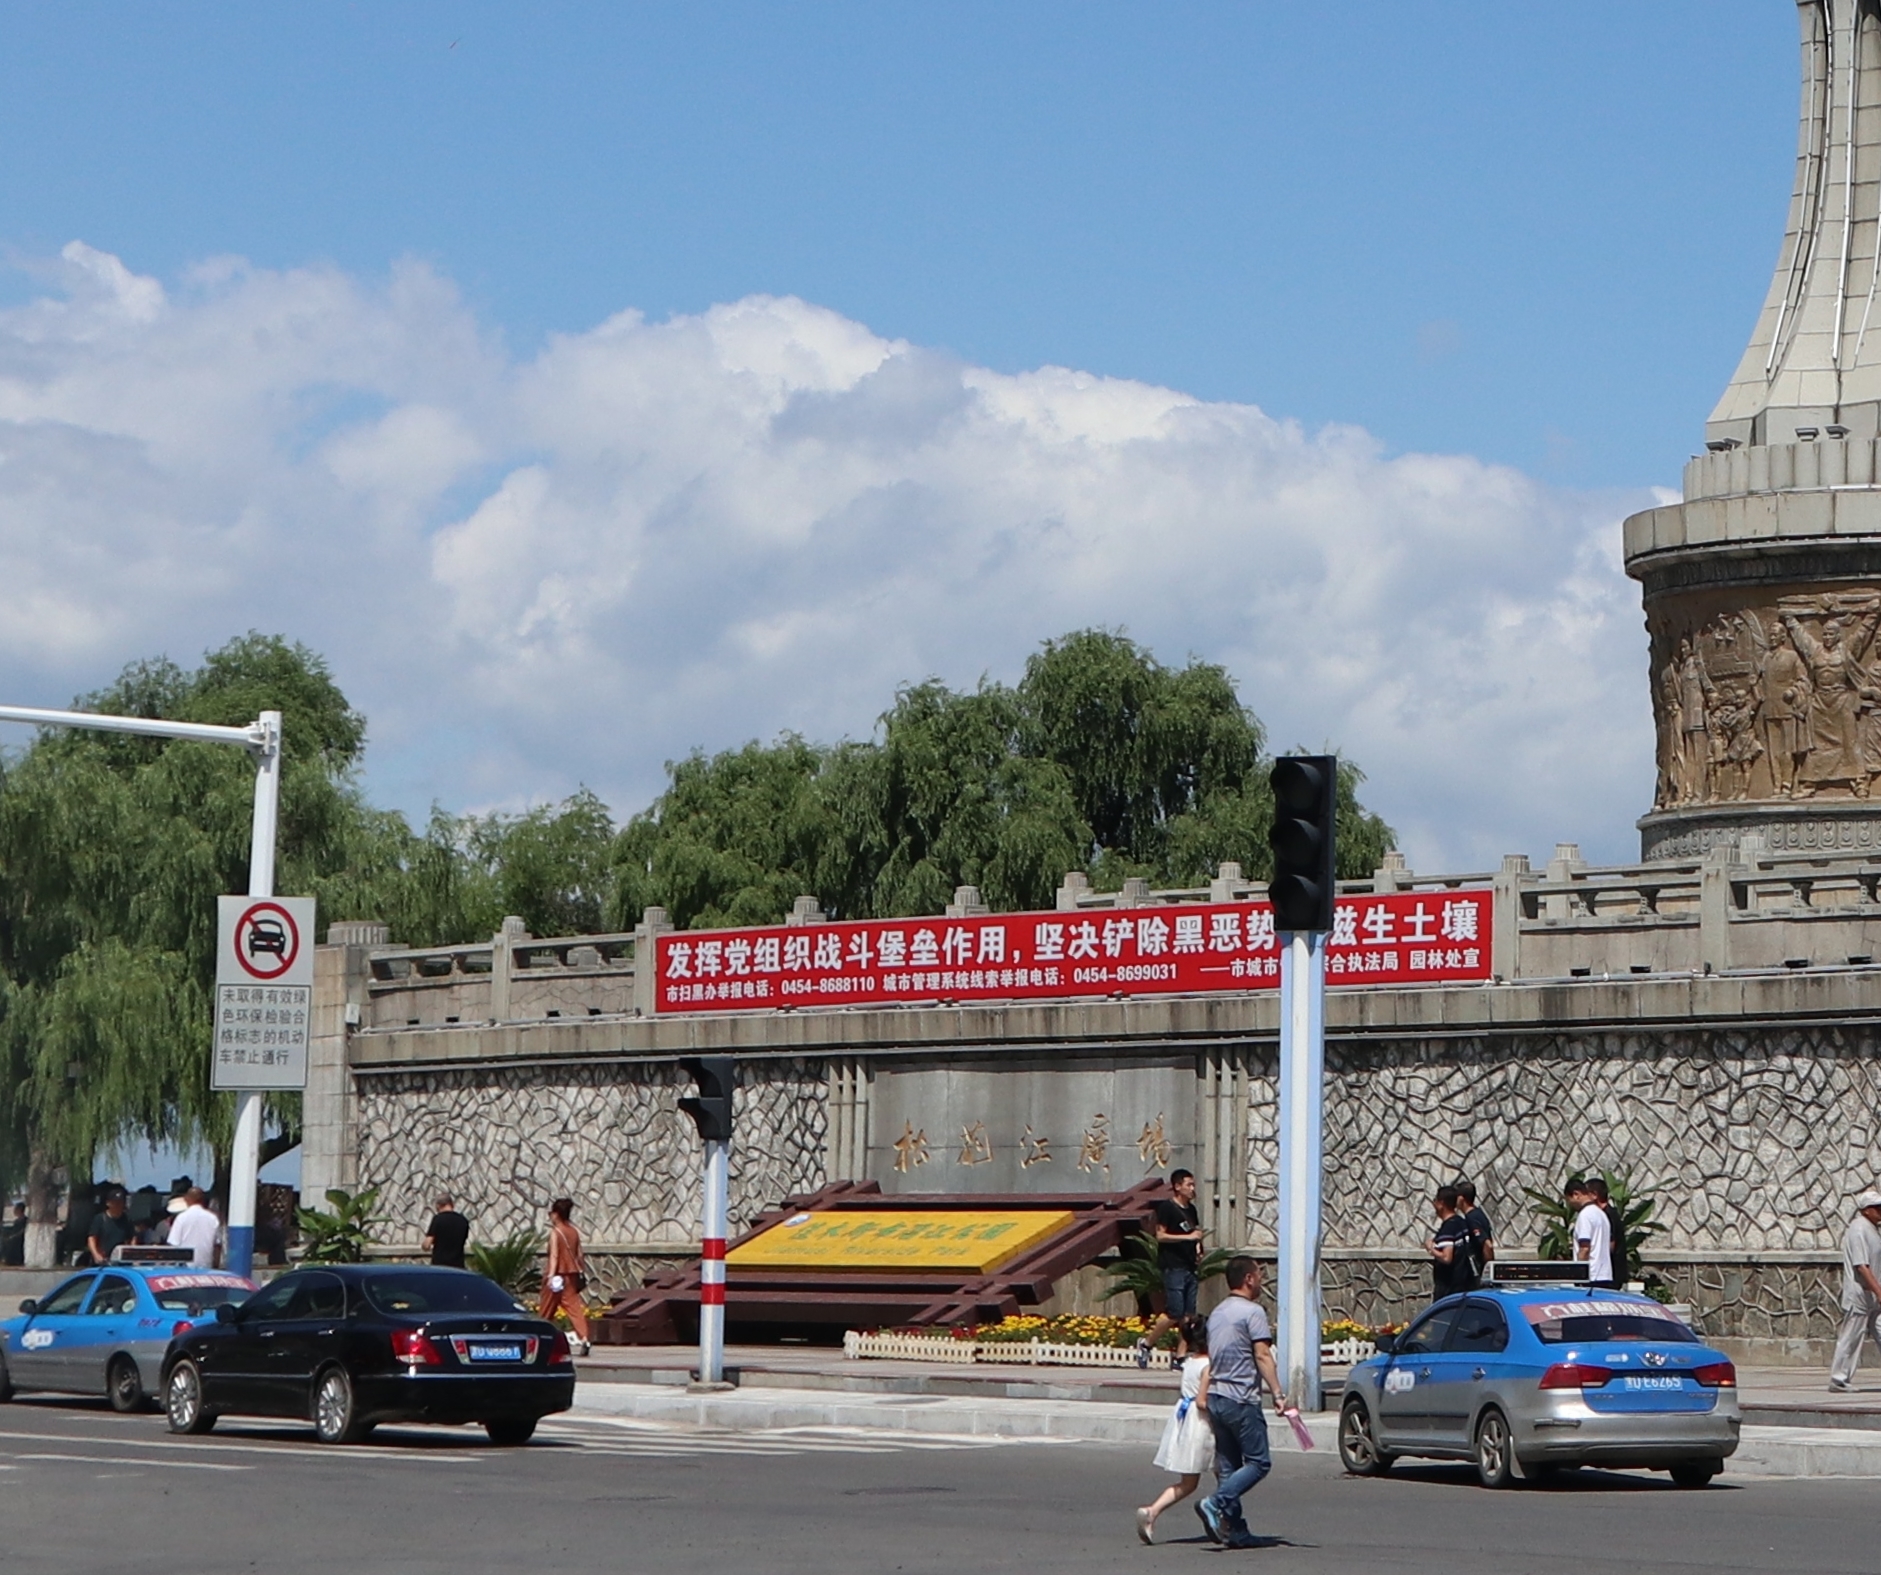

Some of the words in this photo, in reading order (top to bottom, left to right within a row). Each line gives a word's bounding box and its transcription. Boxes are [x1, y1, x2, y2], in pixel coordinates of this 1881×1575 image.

[666, 900, 1479, 979] 发挥党组织战斗堡垒作用，坚决铲除黑恶势滋生土壤
[222, 987, 306, 1004] 未取得有效绿
[222, 1008, 305, 1024] 色环保检验合
[221, 1028, 304, 1044] 格标志的机动
[219, 1048, 289, 1065] 车禁止通行
